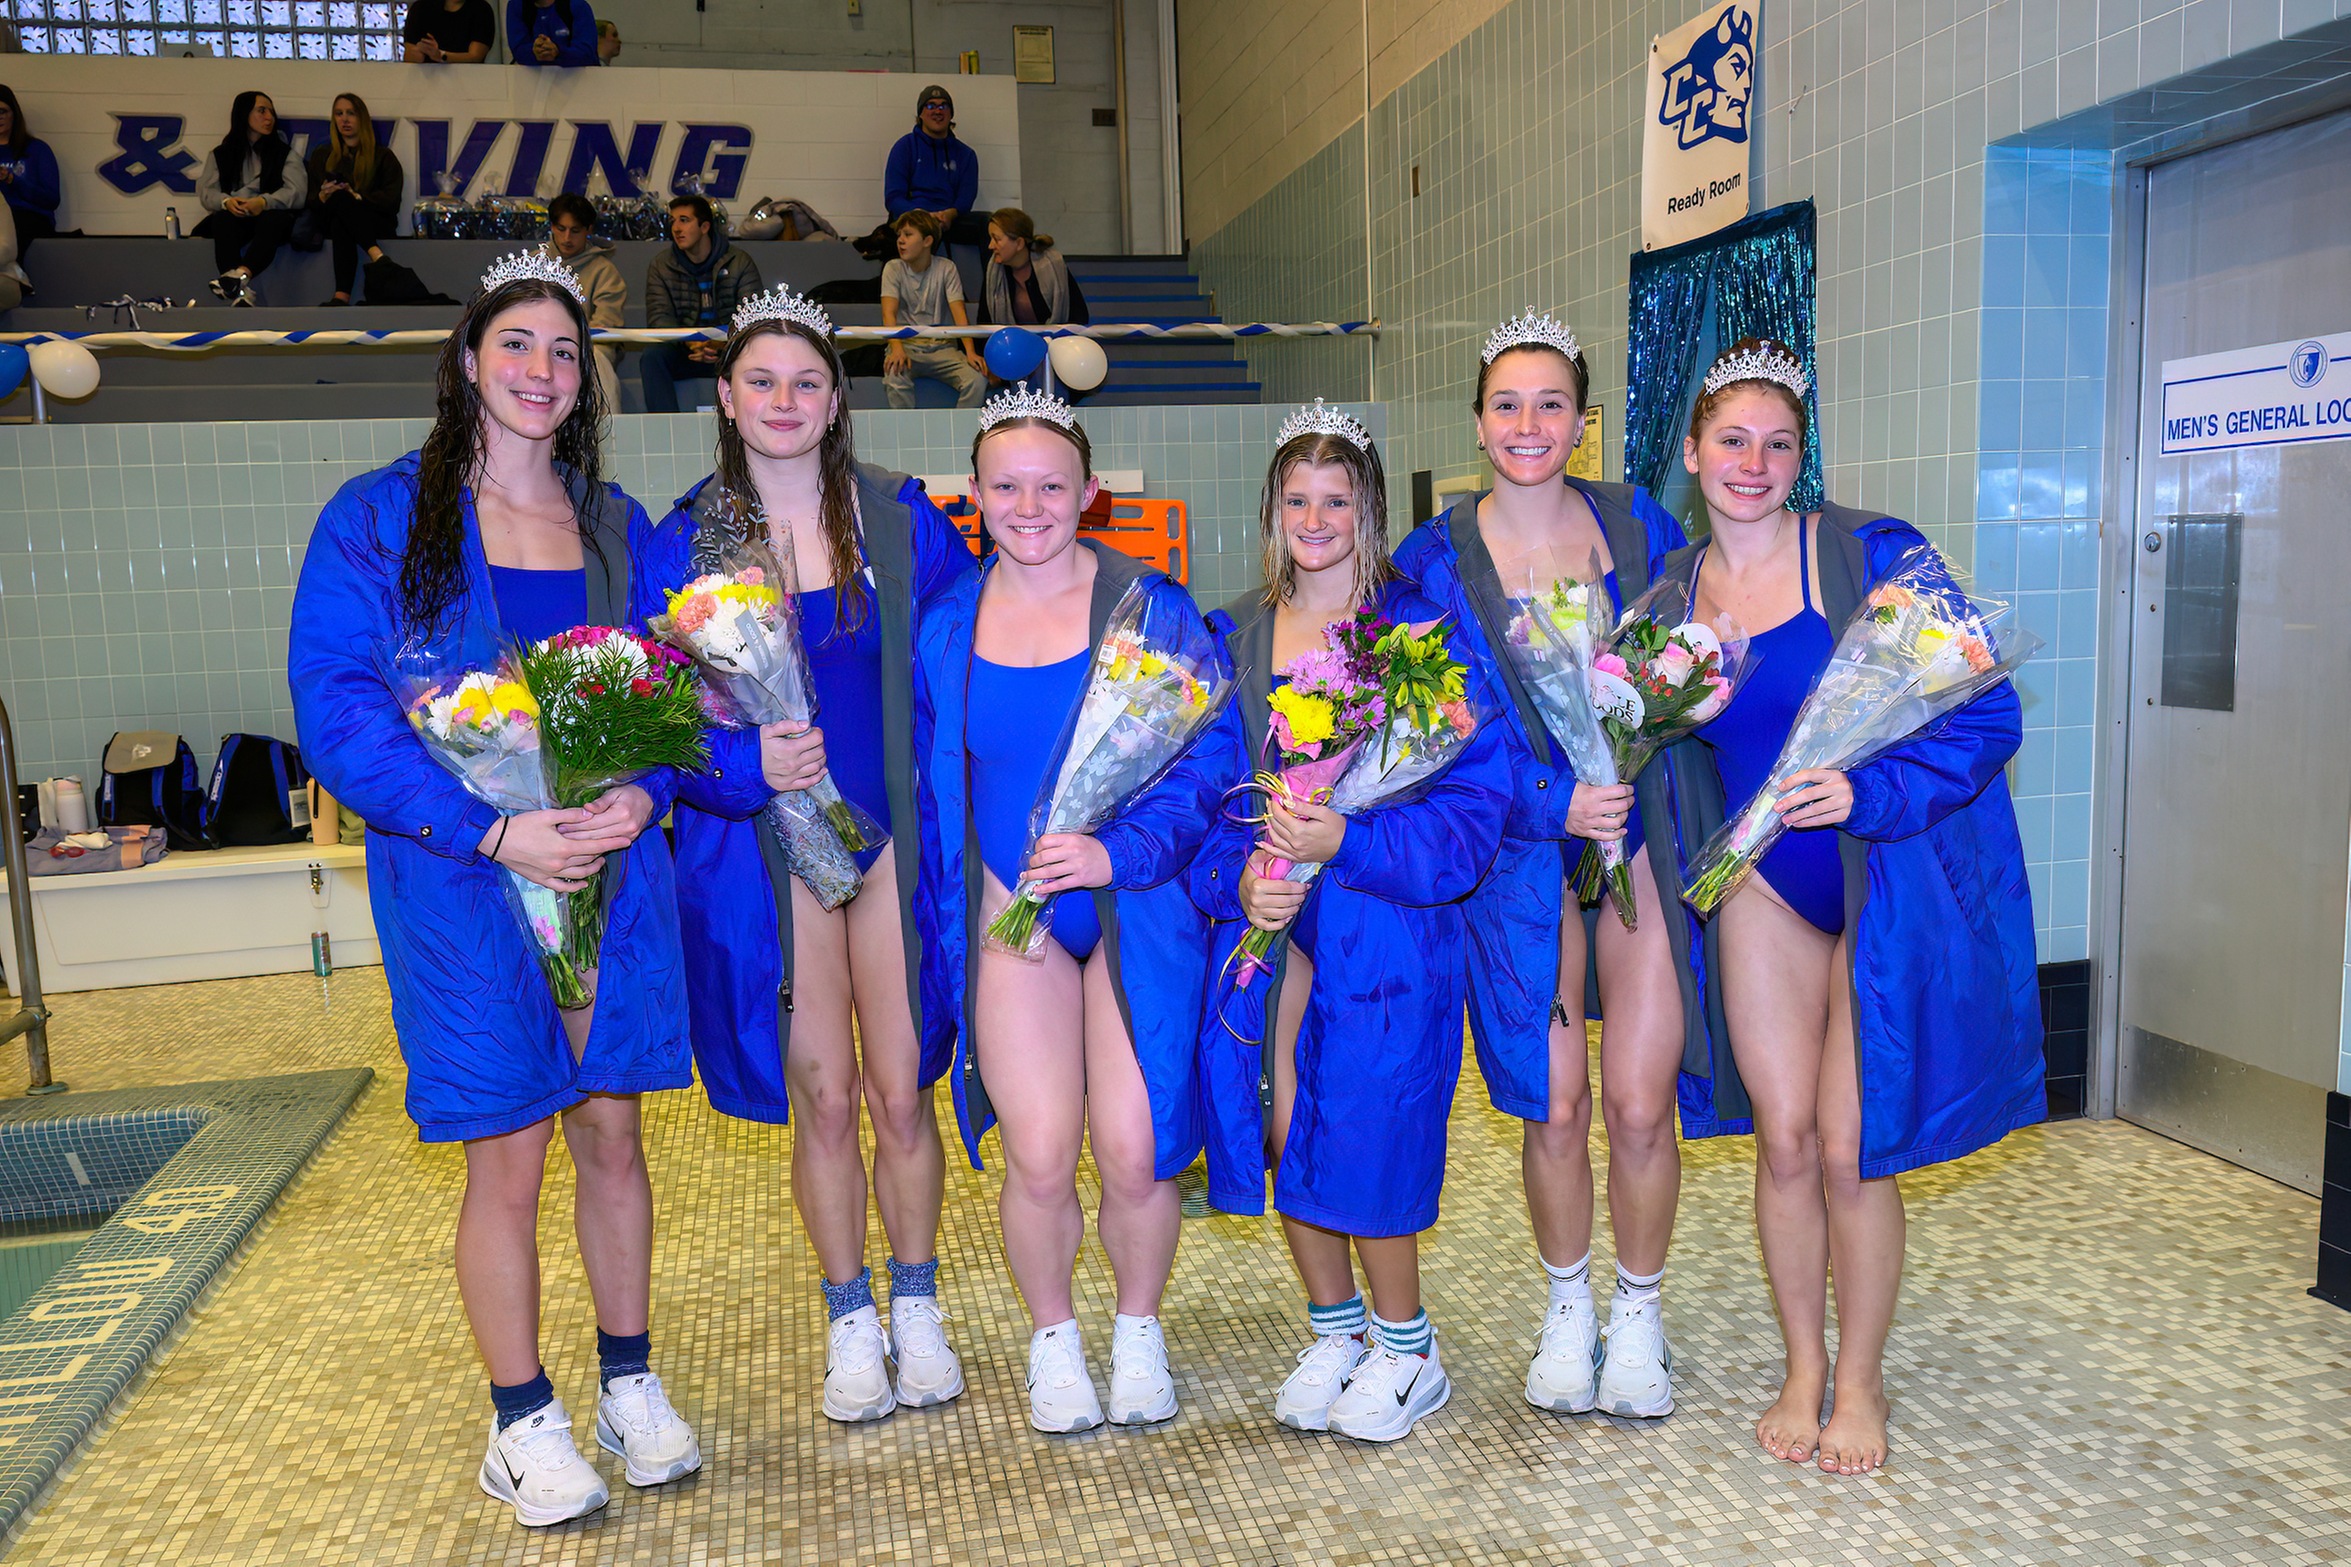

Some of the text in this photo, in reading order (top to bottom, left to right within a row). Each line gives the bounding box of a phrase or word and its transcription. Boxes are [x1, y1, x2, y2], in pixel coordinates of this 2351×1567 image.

[96, 111, 202, 197] &
[1668, 172, 1741, 215] Ready Room
[2168, 413, 2218, 441] MEN'S
[2226, 404, 2310, 435] GENERAL
[1591, 699, 1634, 722] OODS
